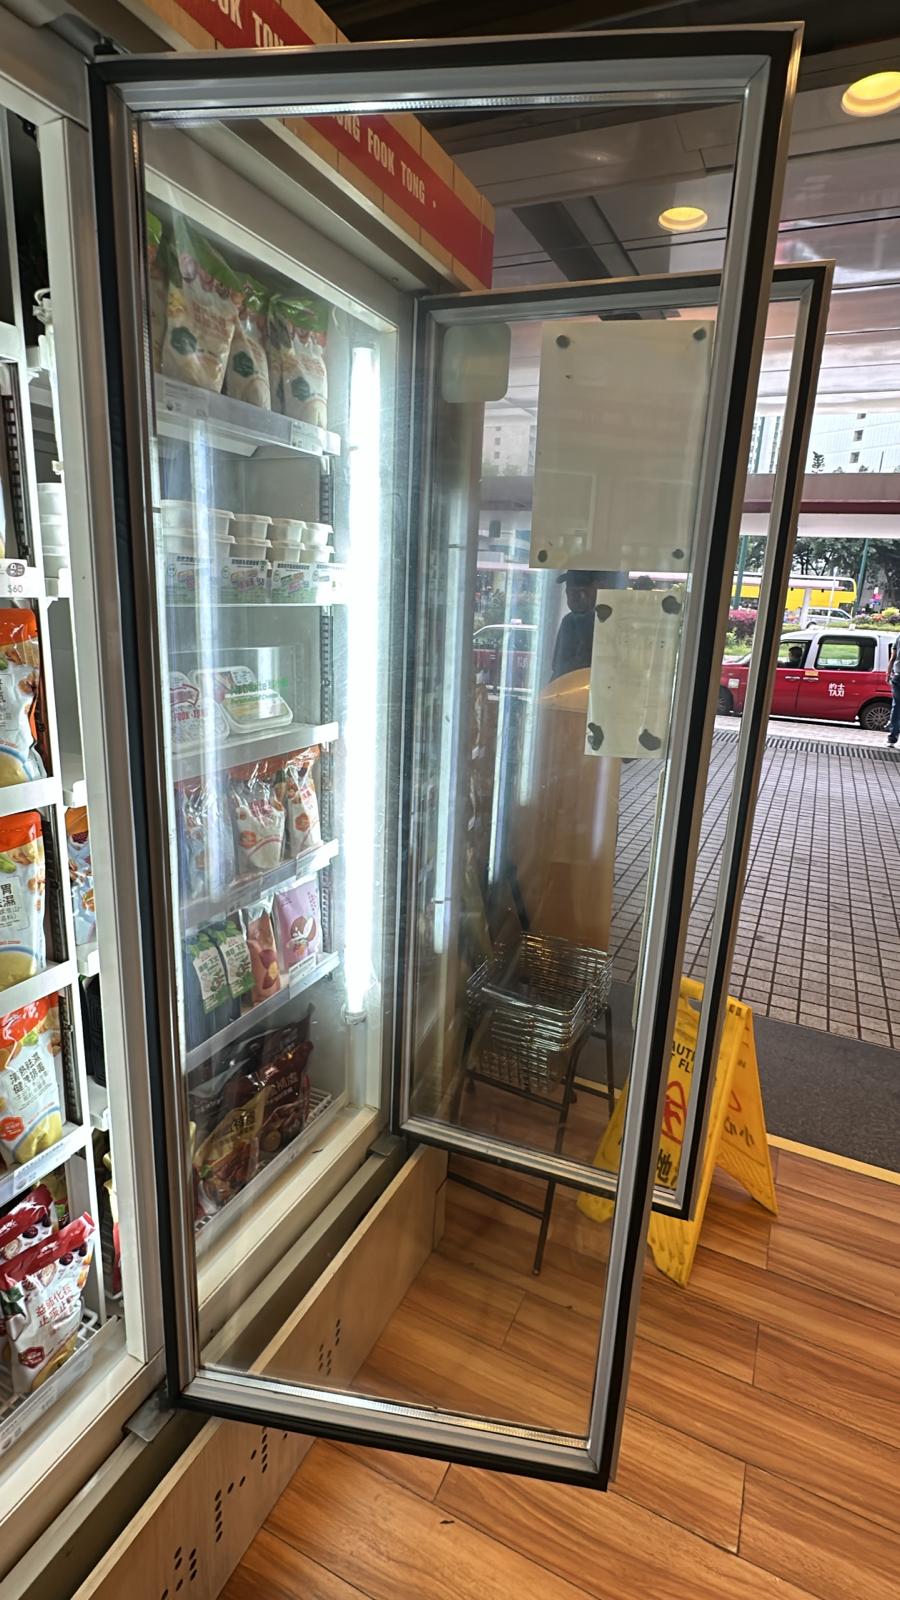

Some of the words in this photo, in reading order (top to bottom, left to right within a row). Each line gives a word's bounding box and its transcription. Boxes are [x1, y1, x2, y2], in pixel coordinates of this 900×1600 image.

[367, 127, 395, 176] FOOK
[400, 160, 425, 205] TONG
[8, 584, 23, 594] $60
[829, 682, 845, 690] 的士
[829, 689, 844, 697] TAXI
[678, 1058, 691, 1074] FL
